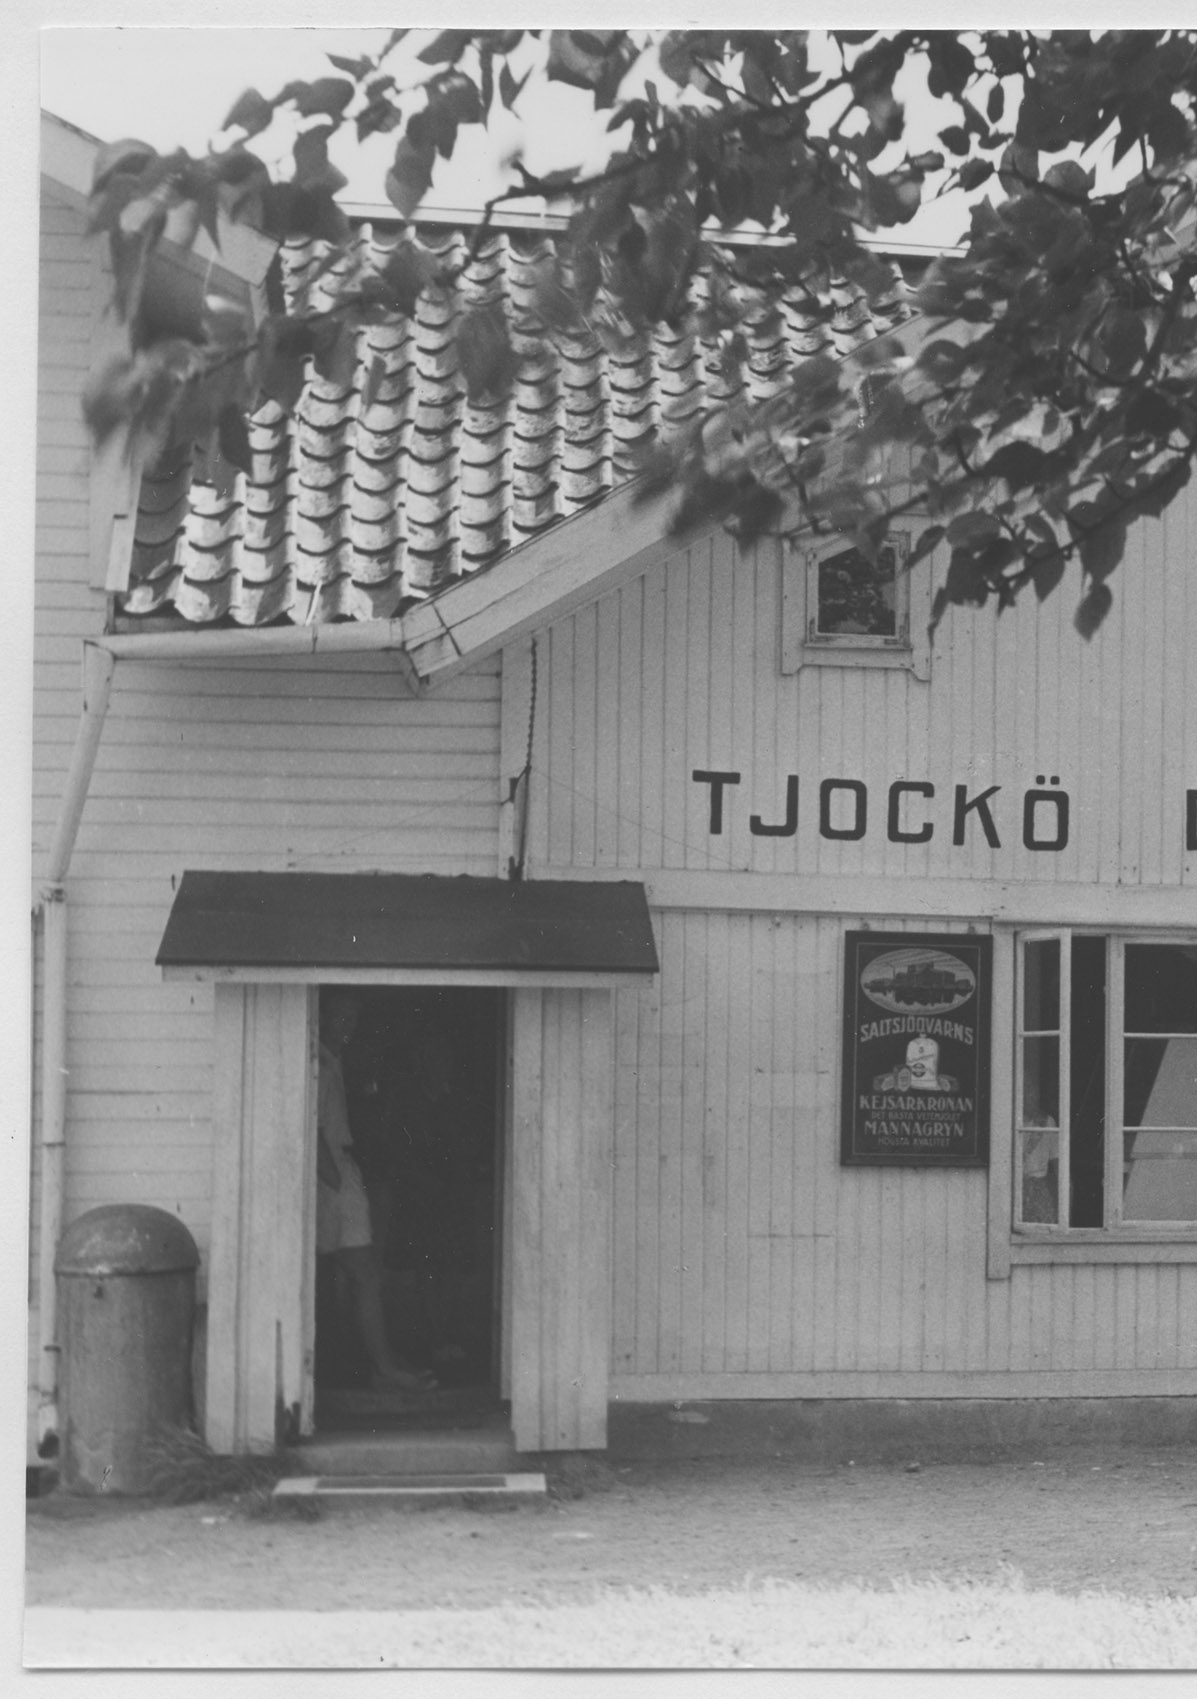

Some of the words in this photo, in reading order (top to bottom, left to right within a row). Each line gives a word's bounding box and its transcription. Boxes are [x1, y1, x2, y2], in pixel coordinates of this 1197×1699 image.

[692, 770, 1070, 852] TJOCKÖ
[859, 1094, 973, 1112] KEJSARKRONAN
[864, 1120, 965, 1137] MANNAGRYN
